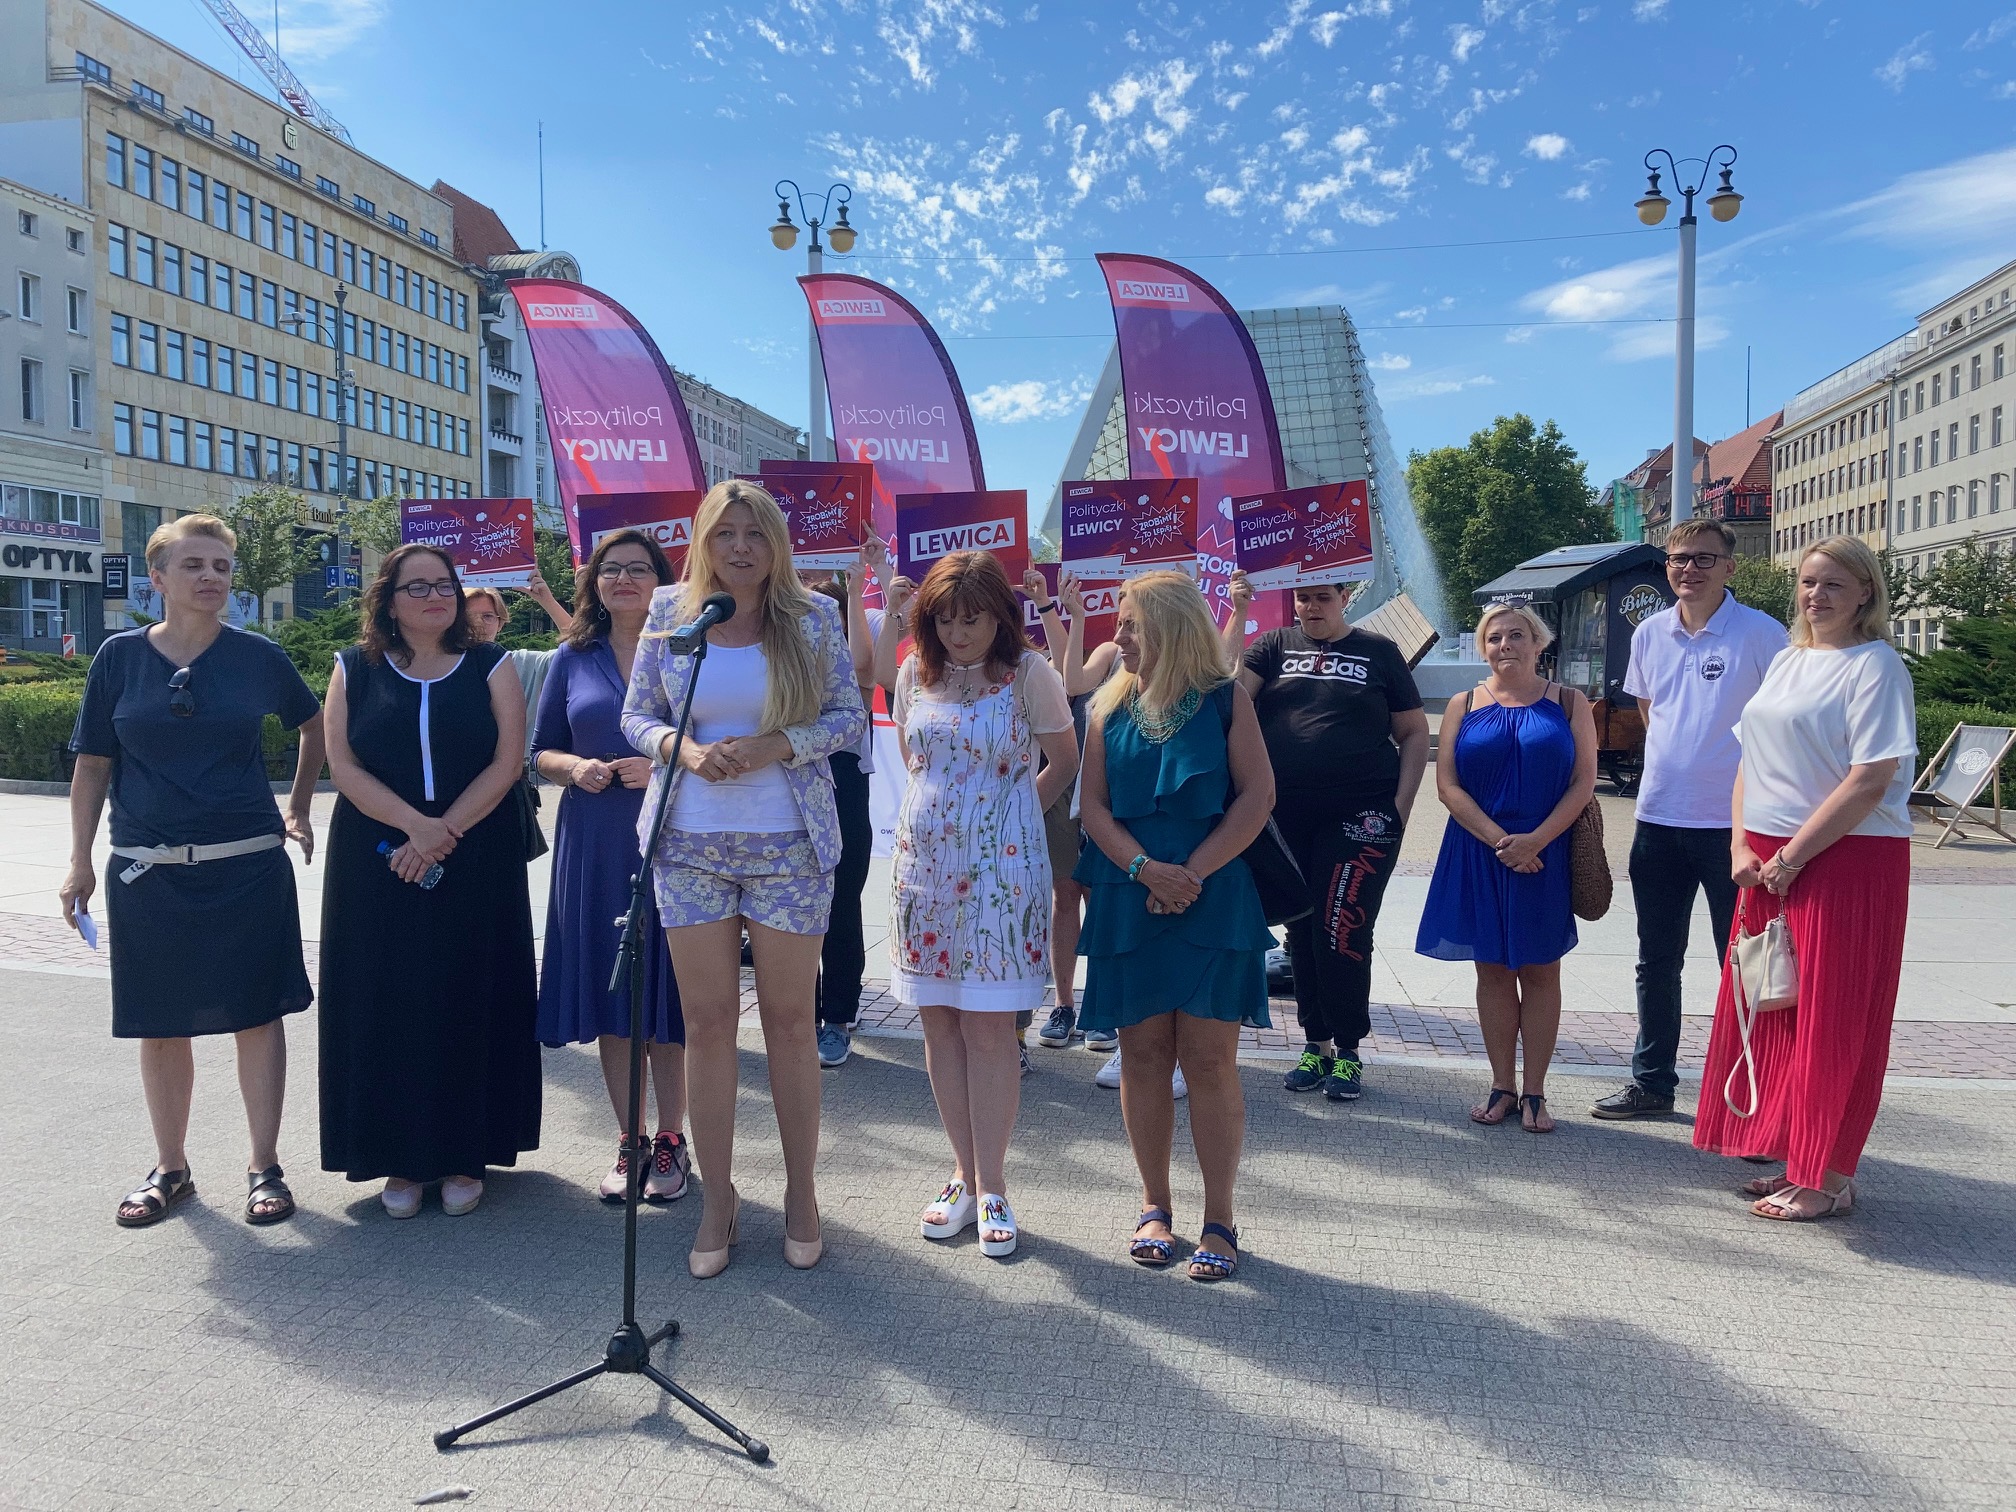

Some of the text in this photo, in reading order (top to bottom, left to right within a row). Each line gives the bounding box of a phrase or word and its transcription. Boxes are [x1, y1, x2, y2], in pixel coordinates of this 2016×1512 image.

[1070, 499, 1126, 517] Polityczki
[1241, 501, 1261, 509] LEWICA
[408, 516, 465, 532] Polityczki
[1070, 519, 1123, 537] LEWICY
[1241, 508, 1297, 532] Polityczki
[916, 524, 1011, 556] LEWICA
[1243, 527, 1295, 551] LEWICY
[2, 544, 94, 574] OPTYK
[1619, 591, 1656, 615] Bike
